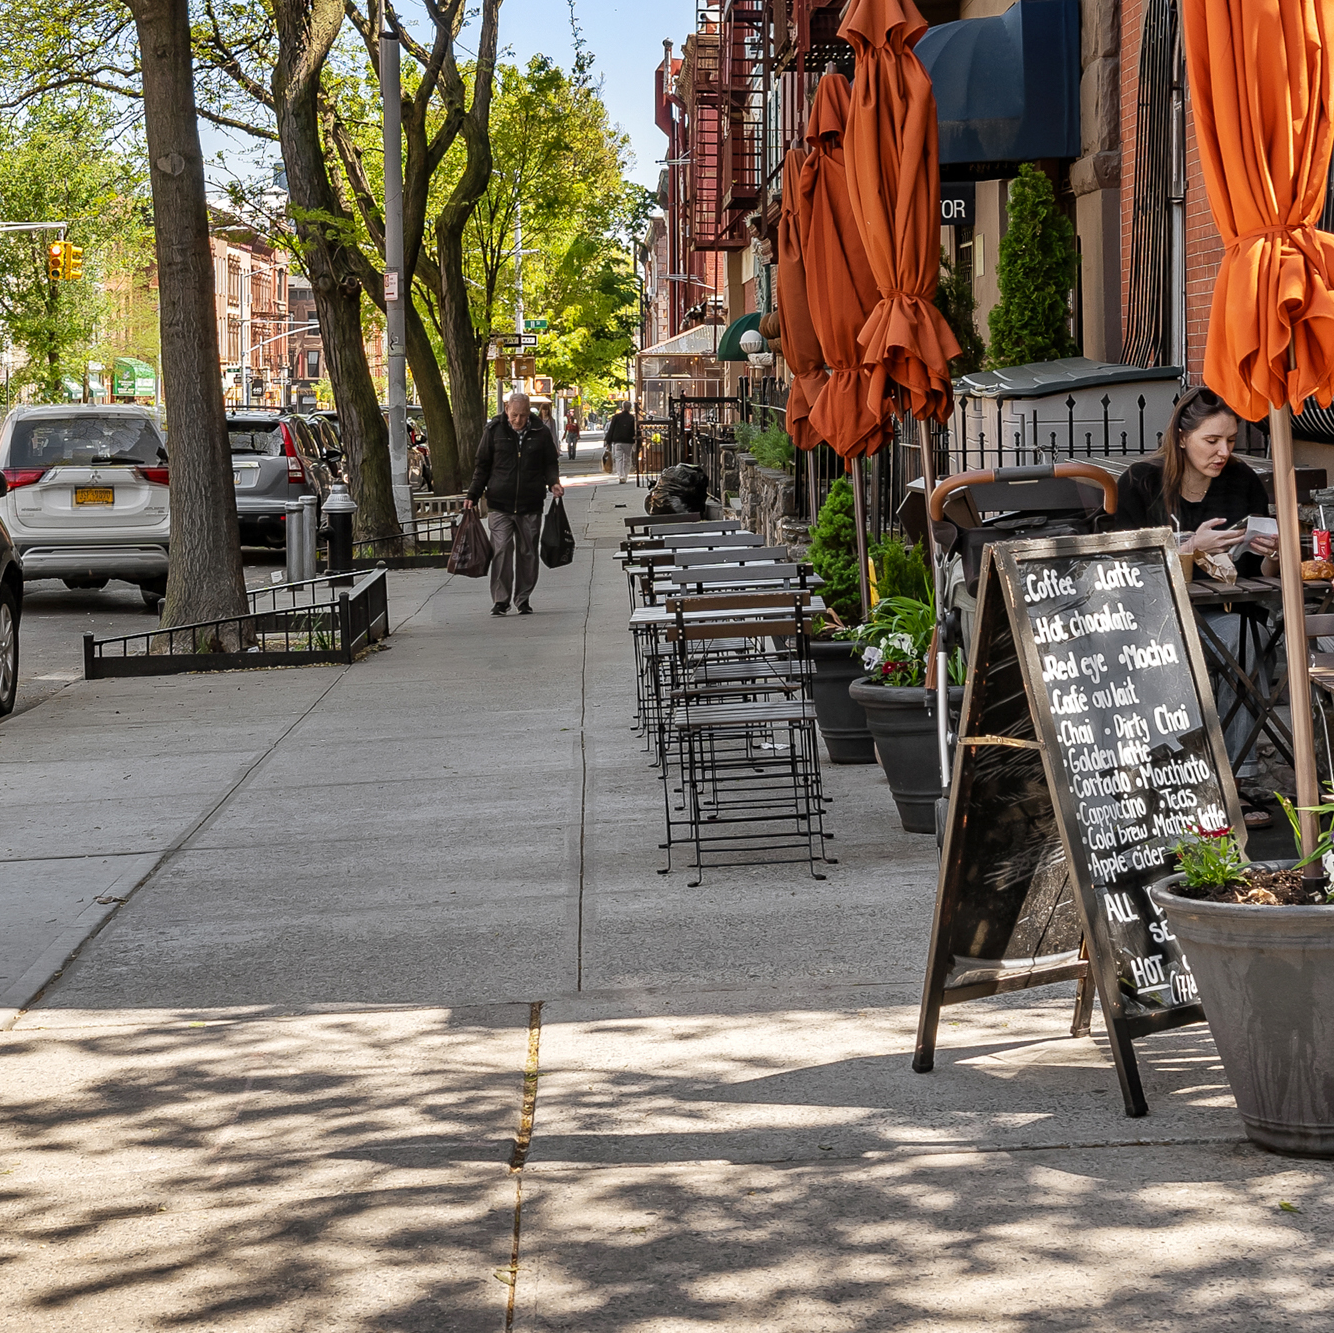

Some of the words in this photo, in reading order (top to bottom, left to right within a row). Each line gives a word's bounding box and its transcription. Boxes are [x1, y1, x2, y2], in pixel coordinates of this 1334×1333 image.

[1026, 569, 1076, 602] Coffee
[1036, 615, 1068, 643] Hot
[1070, 602, 1137, 637] chocolate
[1044, 652, 1080, 681] Red
[1081, 652, 1107, 684] eye
[1123, 639, 1178, 671] Mocha
[1052, 684, 1089, 715] Café
[1092, 688, 1112, 709] au
[1110, 676, 1139, 707] lait
[1061, 719, 1094, 746] Chai
[1113, 712, 1150, 743] Dirty
[1154, 704, 1190, 735] Chai
[1068, 745, 1117, 773] Golden
[1117, 741, 1152, 766] latte
[1073, 771, 1131, 798] Cortado
[1079, 794, 1147, 827] Cappuccino
[1159, 788, 1198, 810] Teas
[1087, 823, 1116, 850] Cold
[1118, 823, 1148, 844] brew
[1092, 853, 1128, 882] Apple
[1132, 845, 1166, 870] cider
[1104, 892, 1138, 923] ALL
[1130, 954, 1166, 988] HOT
